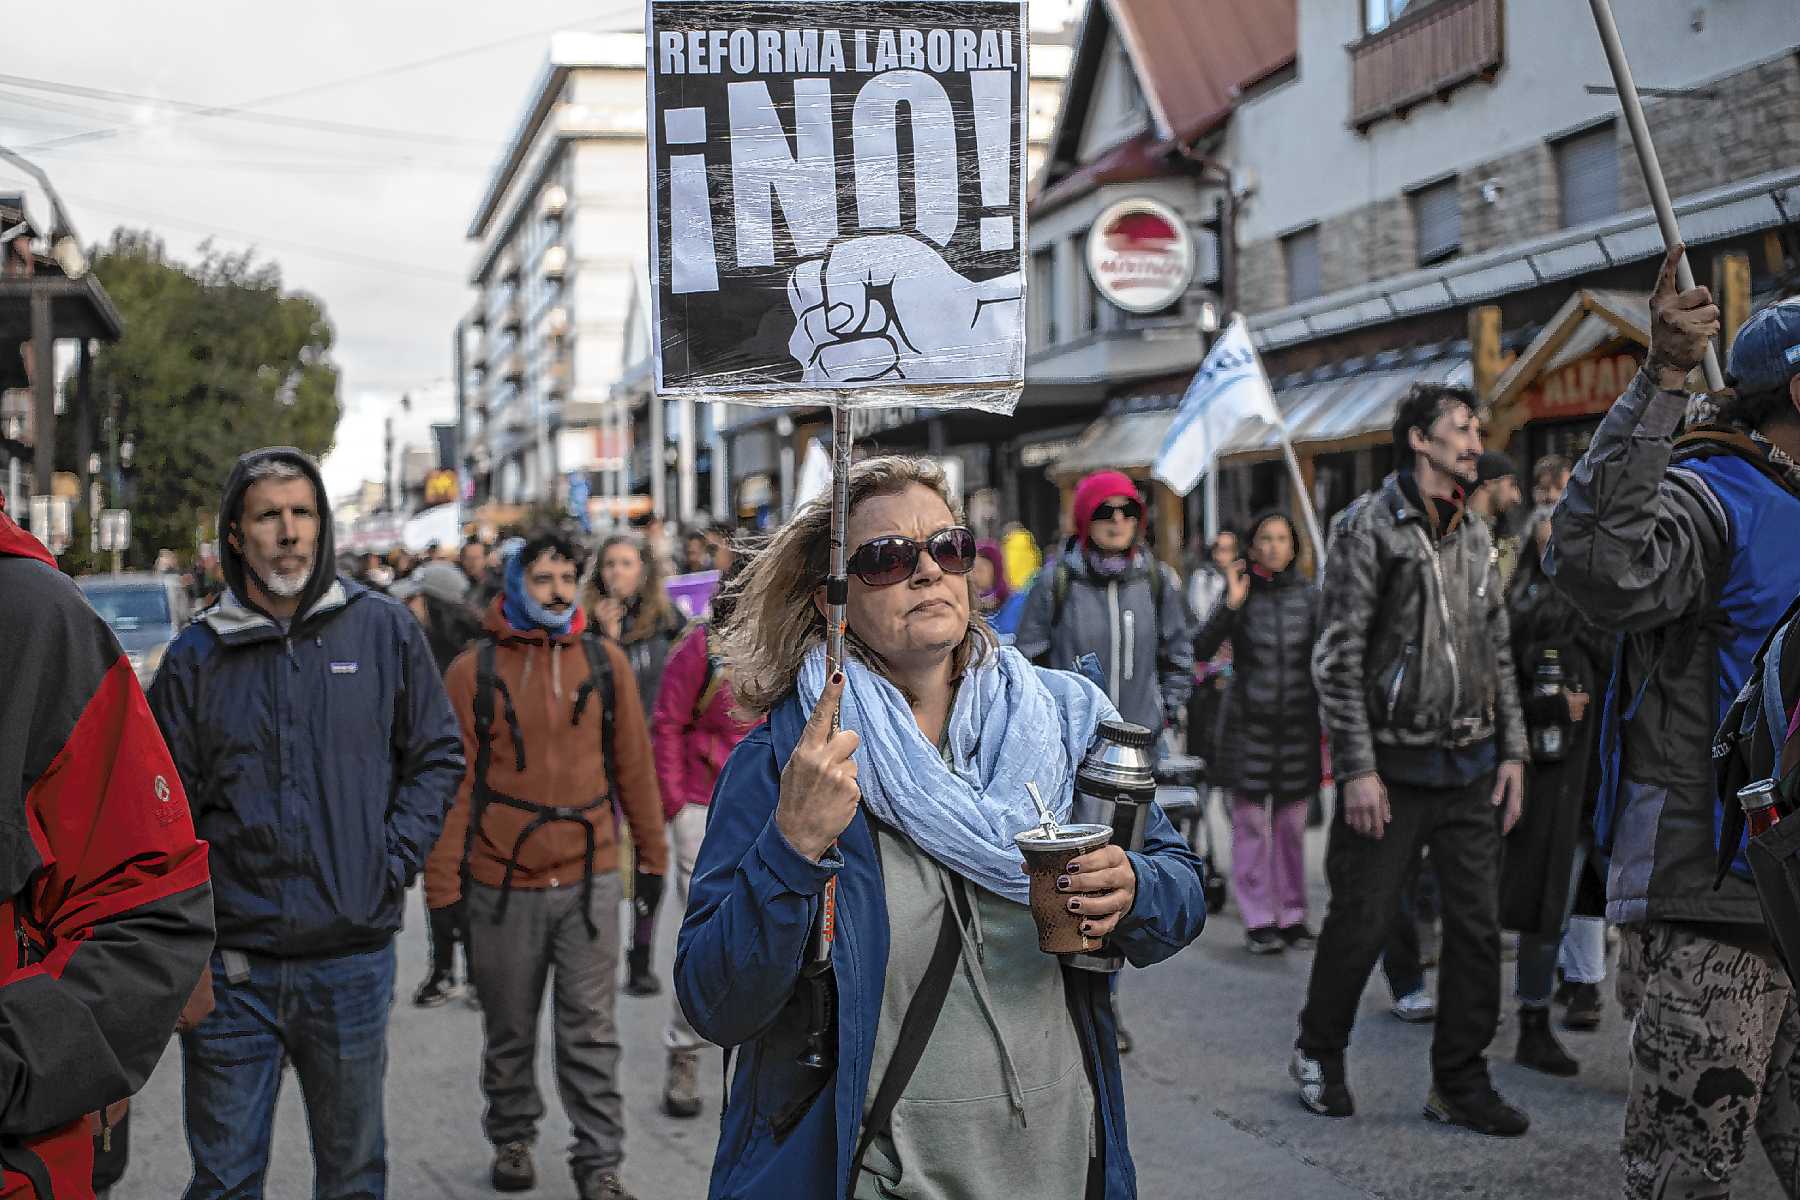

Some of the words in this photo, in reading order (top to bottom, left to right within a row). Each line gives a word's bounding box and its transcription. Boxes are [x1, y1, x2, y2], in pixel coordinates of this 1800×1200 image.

[659, 28, 847, 74] REFORMA
[854, 28, 1018, 73] LABORAL
[664, 70, 1014, 294] ¡NO!
